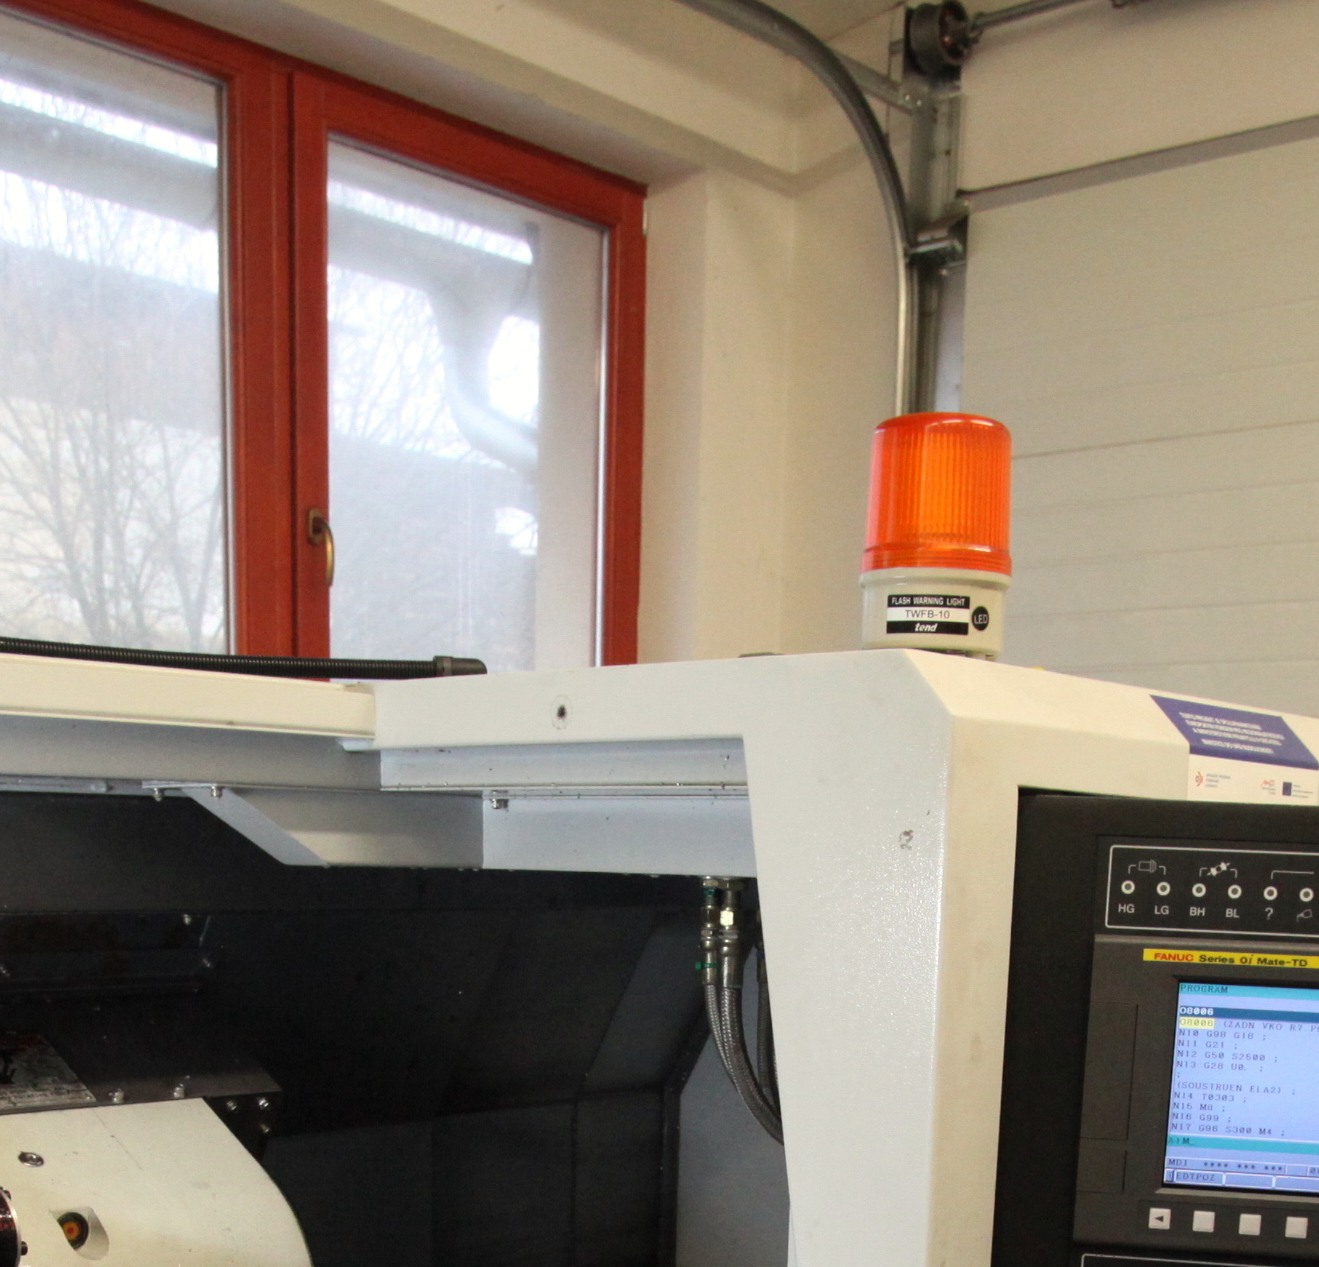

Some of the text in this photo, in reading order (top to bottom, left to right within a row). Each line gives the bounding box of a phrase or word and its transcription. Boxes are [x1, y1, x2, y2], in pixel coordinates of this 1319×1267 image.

[892, 596, 966, 606] FLASH WARNING LIGHT
[904, 610, 950, 619] TWFB-10
[974, 614, 988, 624] LED
[914, 622, 938, 632] tend
[1118, 903, 1135, 914] HG
[1154, 905, 1170, 916] LG
[1190, 906, 1206, 917] BH
[1226, 908, 1240, 918] BL
[1264, 908, 1274, 920] ?
[1154, 952, 1194, 963] FANUC
[1198, 954, 1235, 965] Series
[1256, 956, 1308, 968] Mate-TD
[1180, 984, 1228, 994] PROGRAM
[1178, 1028, 1199, 1037] N10
[1289, 1024, 1303, 1032] R7
[1178, 1040, 1225, 1048] N11 G21
[1177, 1050, 1197, 1058] N12
[1176, 1060, 1197, 1068] N13
[1204, 1061, 1224, 1070] G28
[1174, 1092, 1194, 1100] N14
[1172, 1102, 1193, 1110] N15
[1172, 1112, 1219, 1122] N16 G99
[1171, 1122, 1192, 1131] N17
[1258, 1127, 1272, 1136] M4
[1168, 1158, 1188, 1167] MDI
